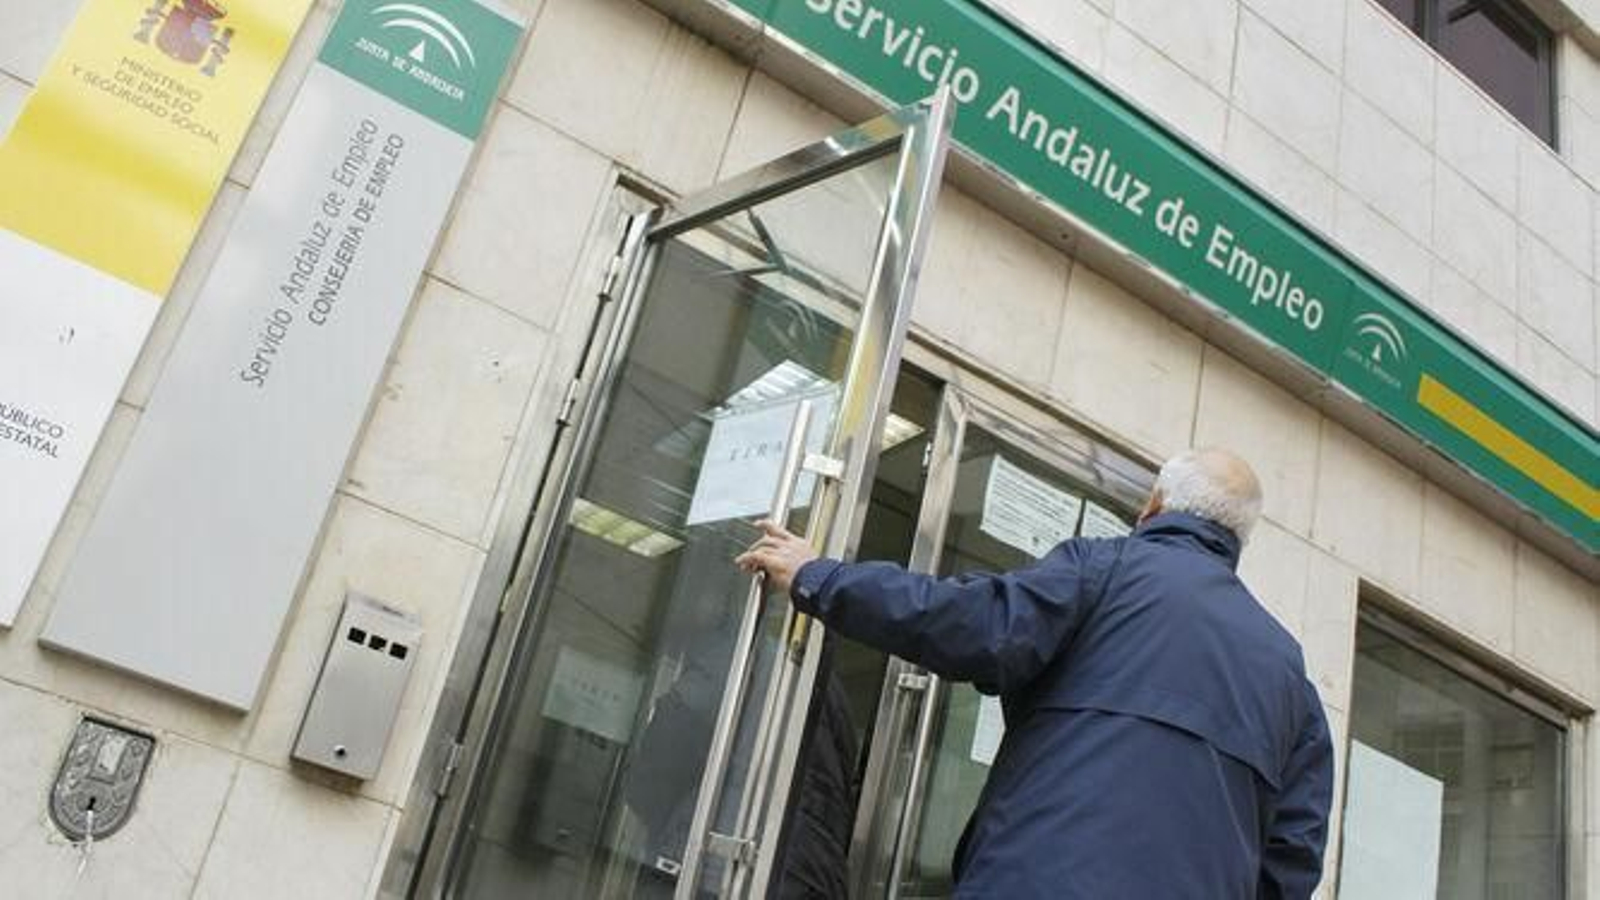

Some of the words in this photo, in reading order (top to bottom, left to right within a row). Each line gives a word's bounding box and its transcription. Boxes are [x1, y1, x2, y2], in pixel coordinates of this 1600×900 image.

[71, 63, 82, 77] Y
[82, 72, 169, 118] SEGURIDAD
[169, 112, 220, 145] SOCIAL
[114, 69, 135, 87] DE
[137, 81, 195, 114] EMPLEO
[121, 56, 203, 103] MINISTERIO
[331, 118, 379, 188] Empleo
[308, 226, 365, 326] CONSEJERIA
[352, 197, 376, 223] DE
[365, 133, 405, 198] EMPLEO
[322, 191, 346, 219] de
[985, 86, 1151, 216] Andaluz
[1155, 198, 1200, 248] de
[1204, 224, 1324, 331] Empleo
[279, 220, 333, 305] Andaluz
[240, 307, 293, 388] Servicio
